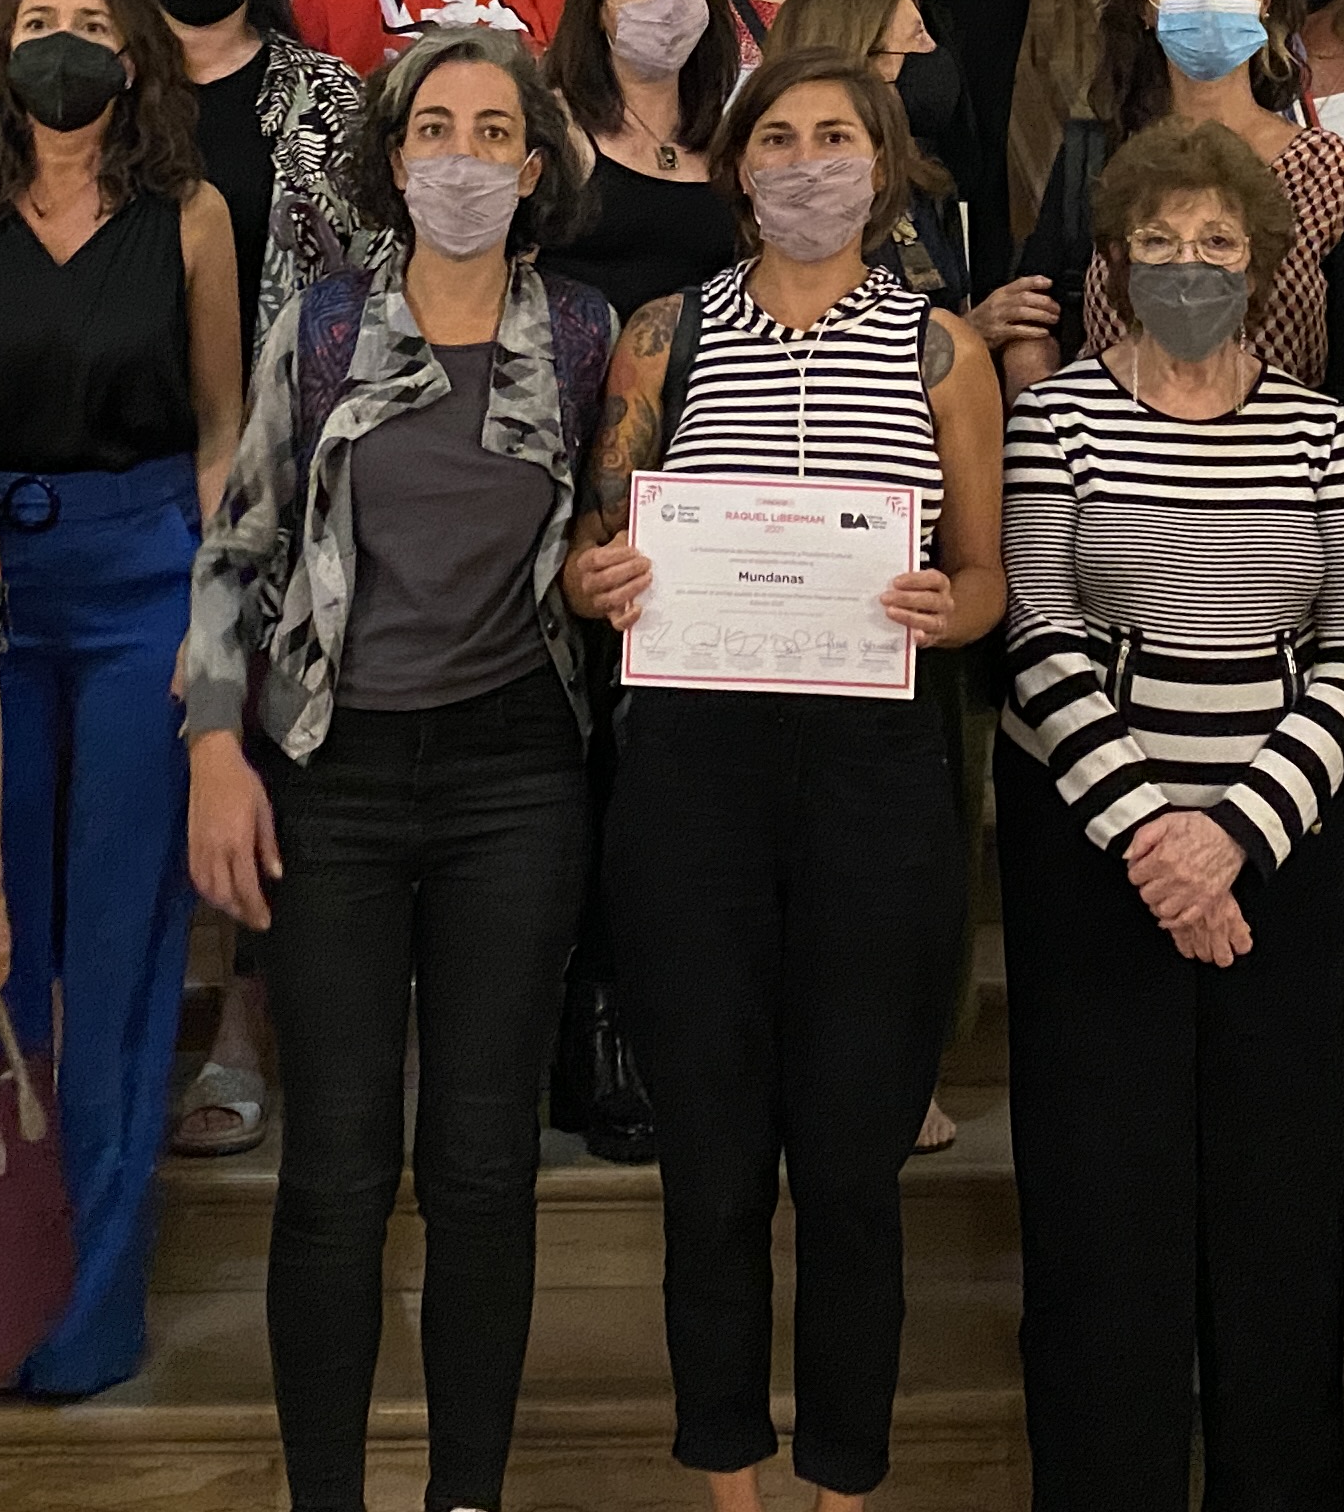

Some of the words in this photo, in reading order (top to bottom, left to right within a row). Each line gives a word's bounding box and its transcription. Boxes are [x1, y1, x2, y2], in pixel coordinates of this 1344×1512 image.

[725, 511, 769, 522] RAQUEL
[840, 513, 869, 530] BA
[738, 571, 805, 584] Mundanas
